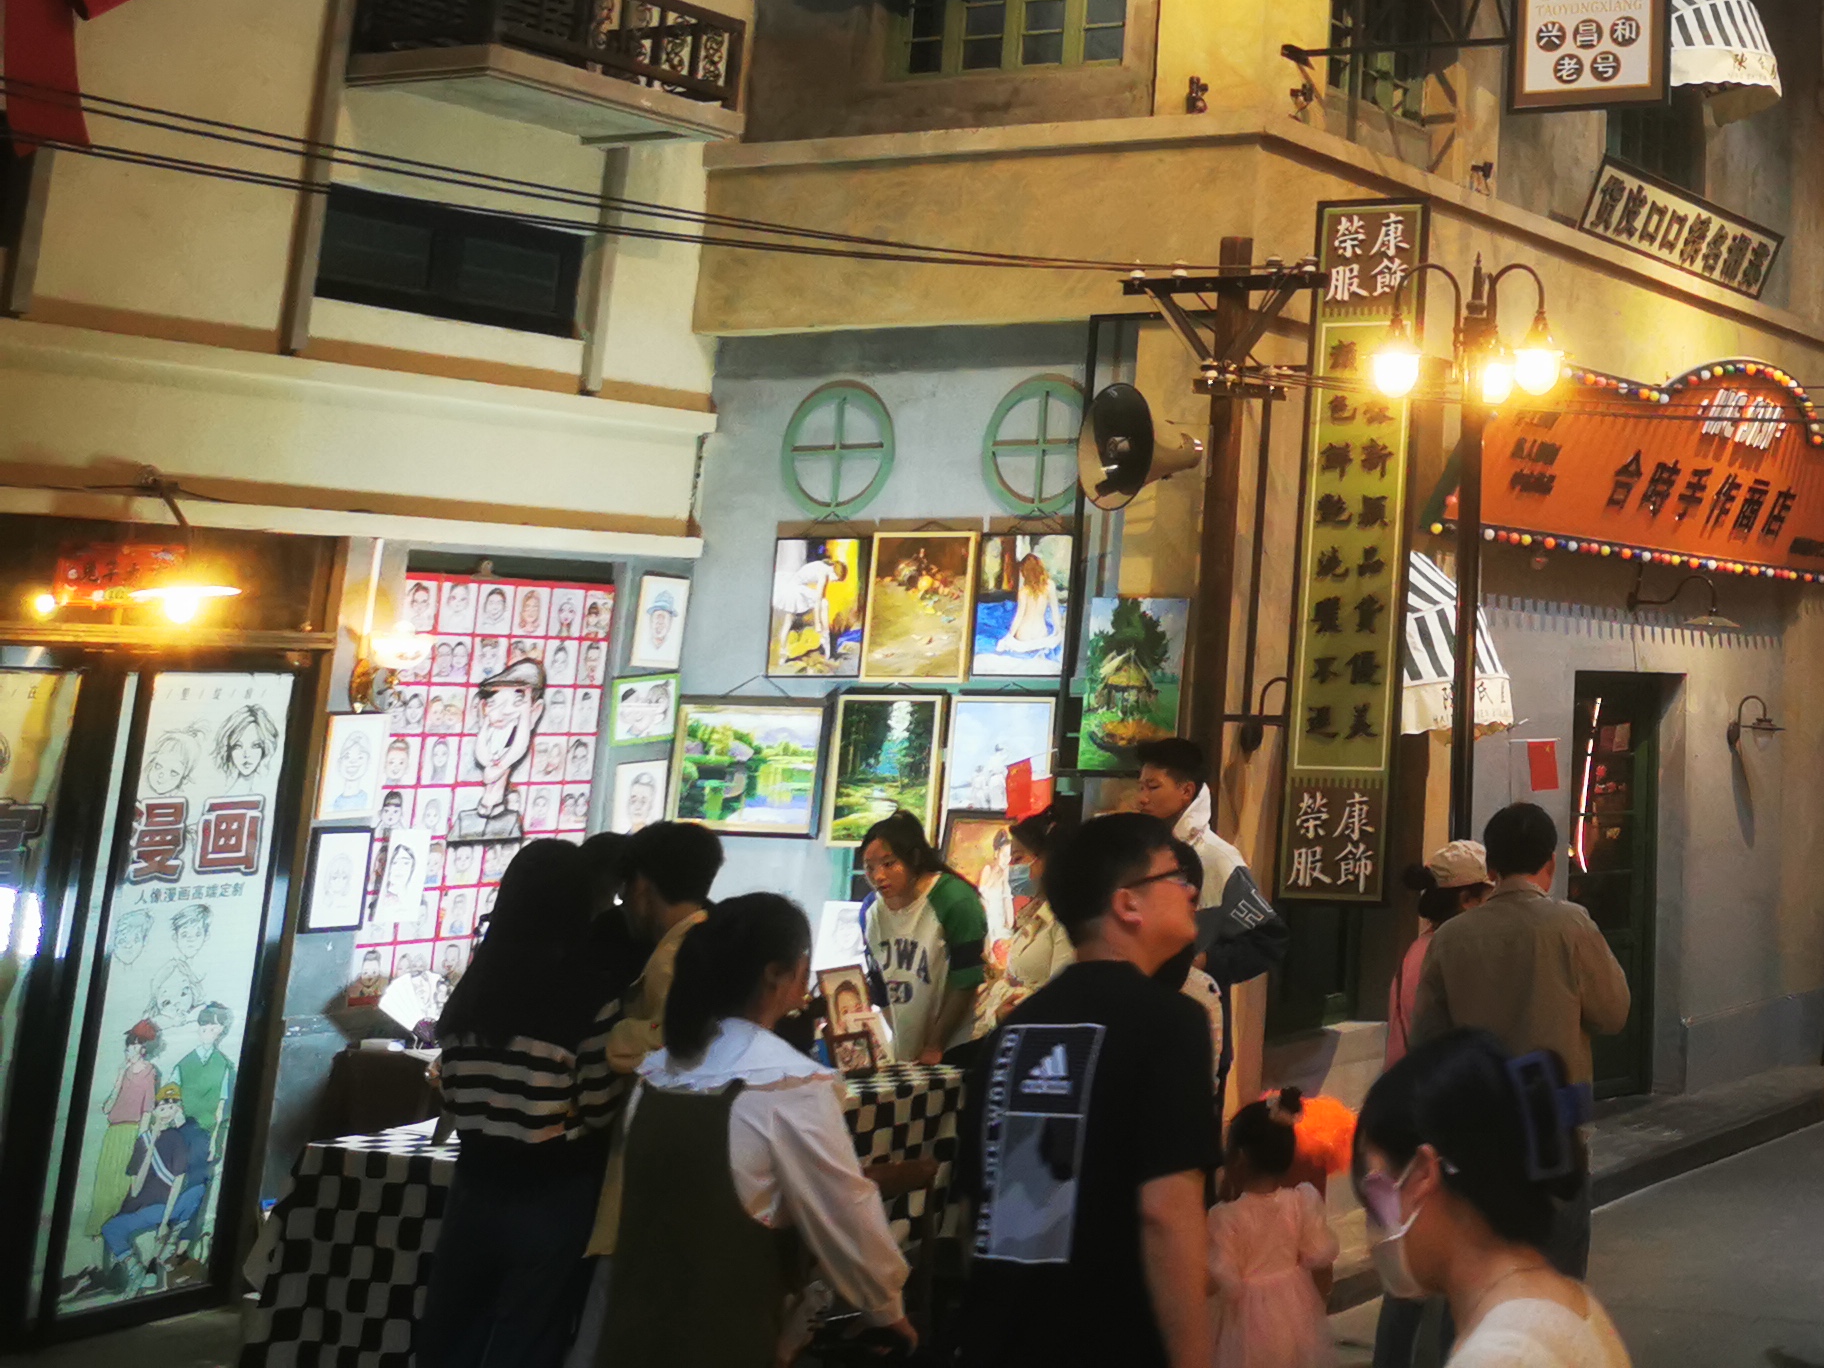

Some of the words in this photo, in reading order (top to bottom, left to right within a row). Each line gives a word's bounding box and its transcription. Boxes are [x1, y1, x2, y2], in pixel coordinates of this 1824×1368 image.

[1538, 18, 1638, 48] 兴昌和
[1555, 52, 1618, 81] 老号
